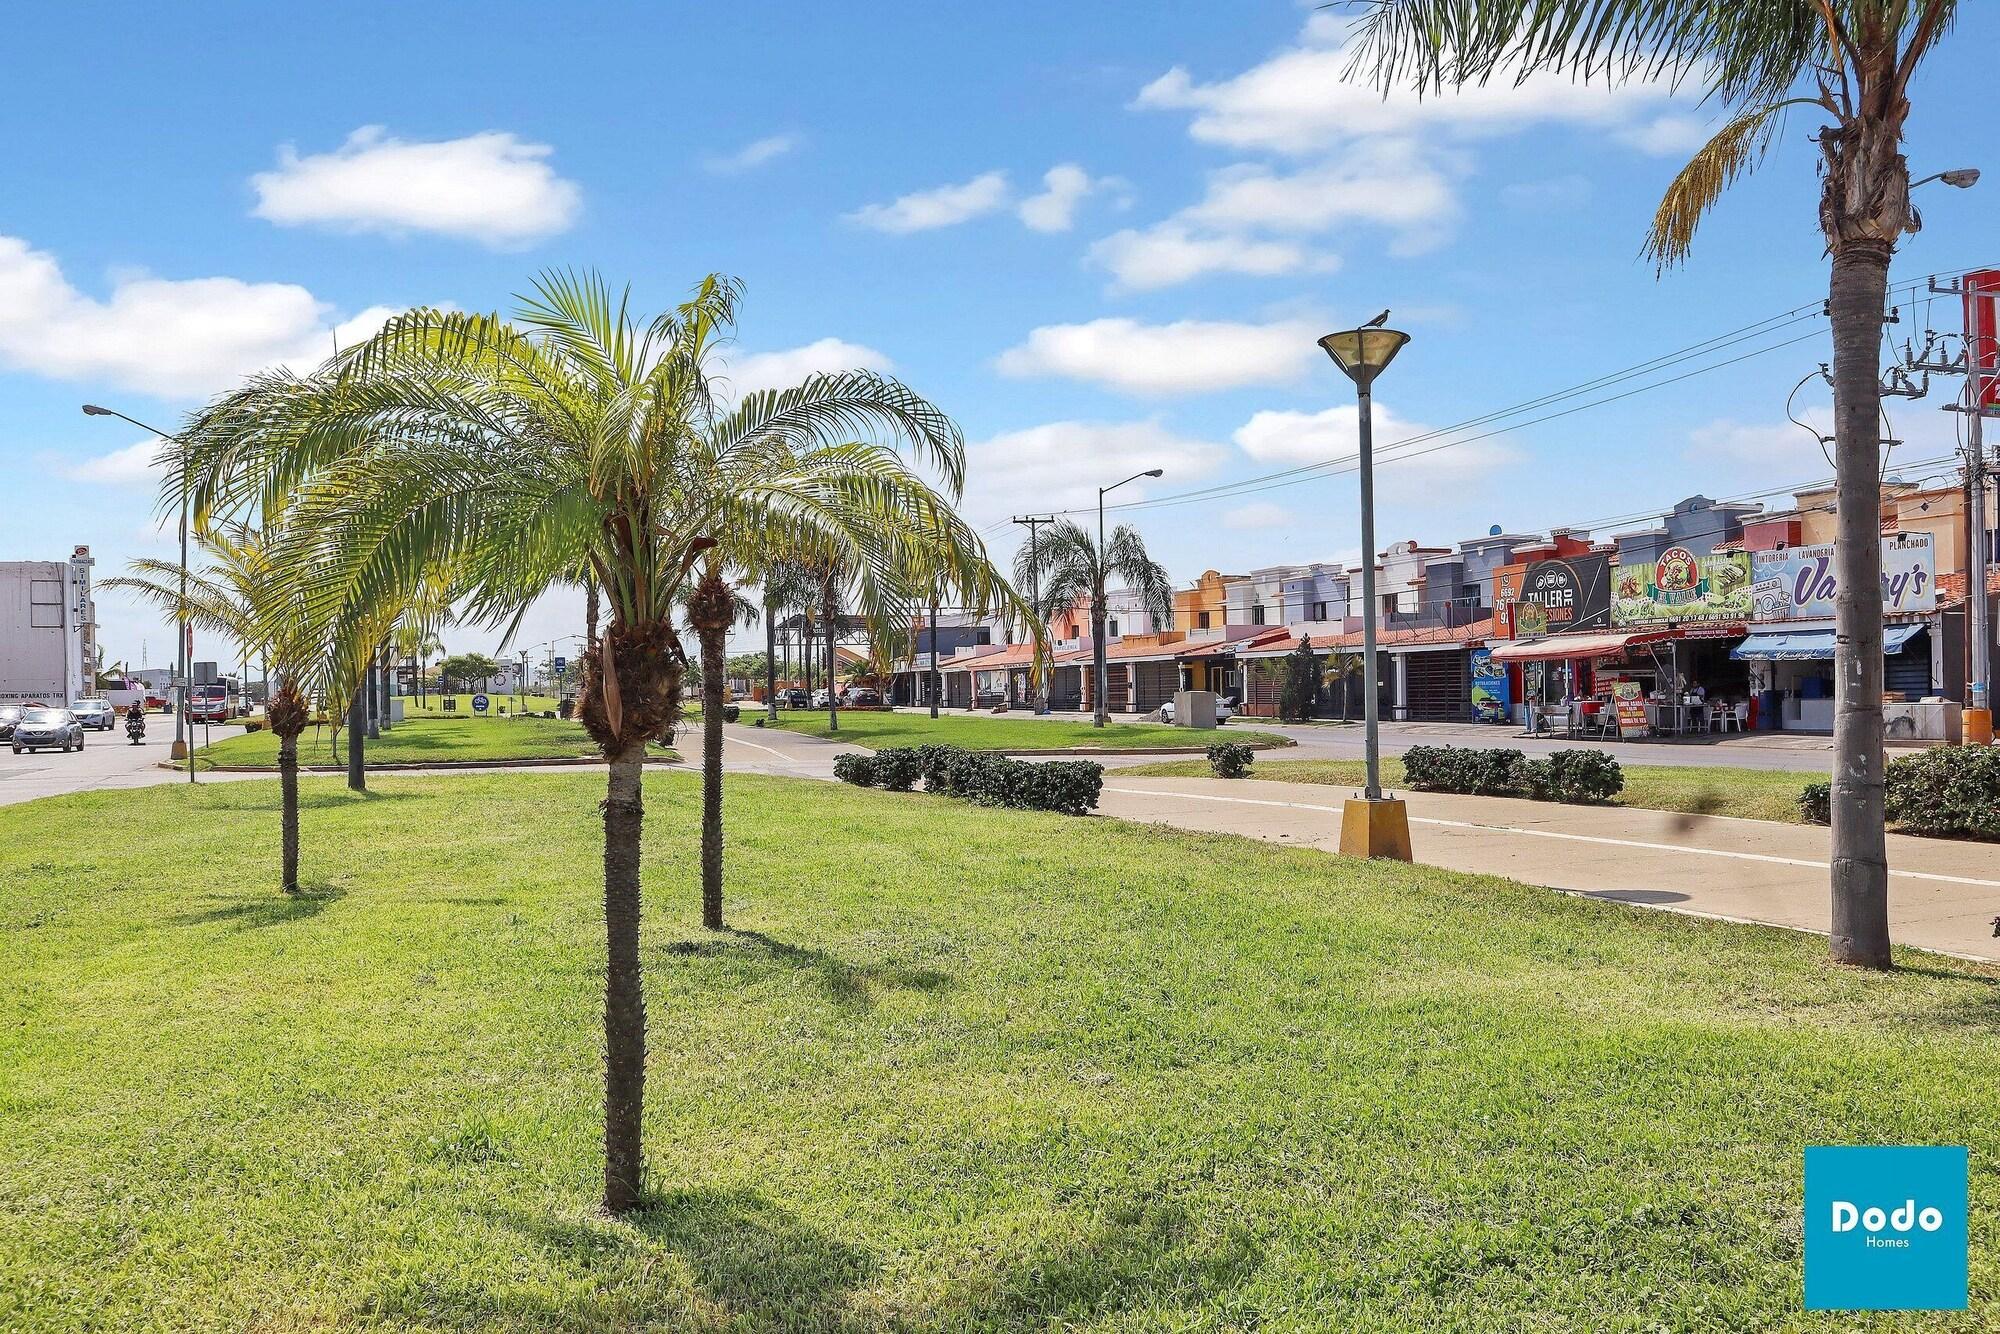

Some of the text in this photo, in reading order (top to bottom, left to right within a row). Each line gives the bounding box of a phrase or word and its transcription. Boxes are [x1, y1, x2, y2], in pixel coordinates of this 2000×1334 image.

[1889, 538, 1929, 551] PLANCHADO
[1661, 551, 1693, 567] TACOS
[1756, 548, 1835, 564] TINTORERIA LAVANDERIA
[79, 567, 87, 622] SIMILARES
[1501, 588, 1515, 597] 6692
[1563, 588, 1573, 606] DE
